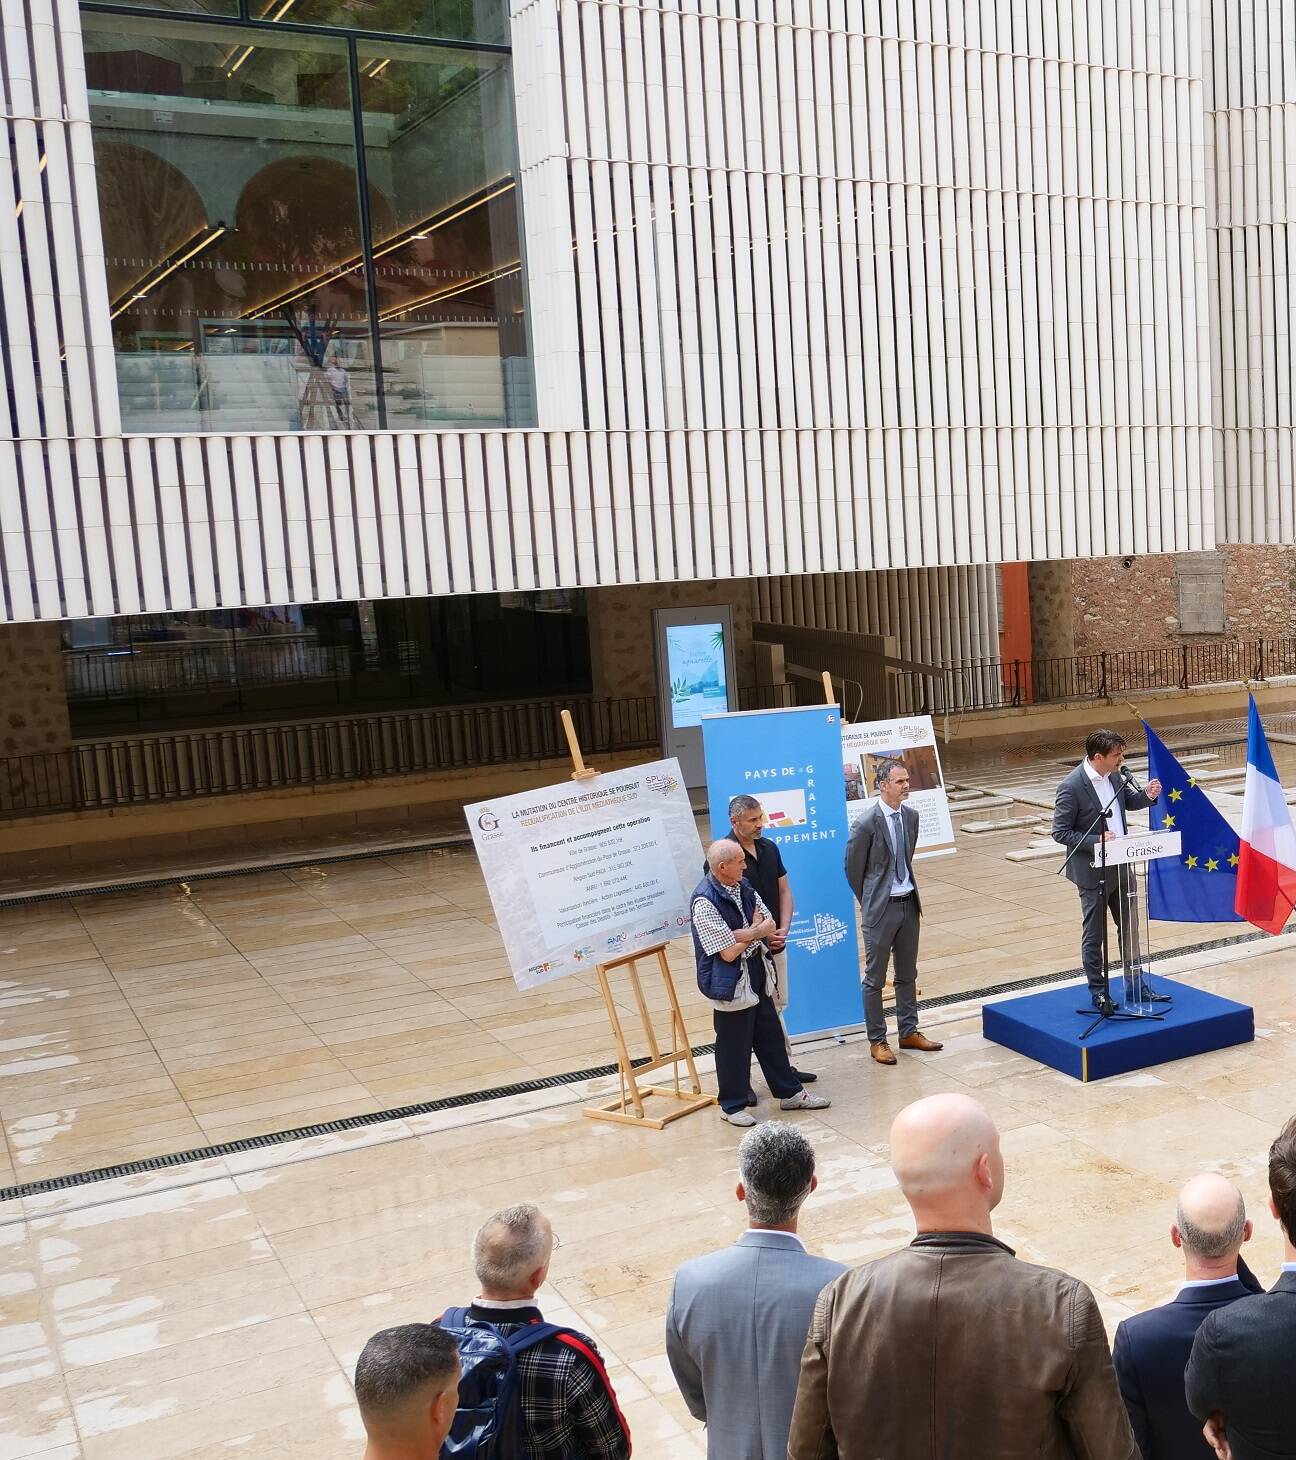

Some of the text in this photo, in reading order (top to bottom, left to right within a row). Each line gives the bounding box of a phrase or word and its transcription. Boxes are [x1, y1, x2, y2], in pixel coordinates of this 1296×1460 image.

[898, 725, 913, 733] SPL
[646, 775, 661, 784] SPL
[745, 767, 795, 780] PAYS DE
[511, 811, 520, 819] LA
[520, 803, 548, 817] MUTATION
[548, 802, 557, 810] DU
[557, 796, 578, 808] CENTRE
[578, 788, 608, 802] HISTORIQUE
[608, 787, 616, 795] SE
[616, 781, 640, 794] POURSUIT
[520, 810, 568, 827] REQUALIFICATION
[568, 808, 576, 816] DE
[624, 792, 637, 801] SUD
[477, 812, 500, 832] G
[481, 831, 504, 841] Grasse
[531, 845, 539, 853] Ils
[539, 839, 566, 850] financent
[566, 836, 573, 844] et
[573, 826, 612, 843] accompagnent
[612, 822, 626, 832] cette
[767, 829, 836, 845] PPEMENT
[1126, 845, 1163, 858] Grasse
